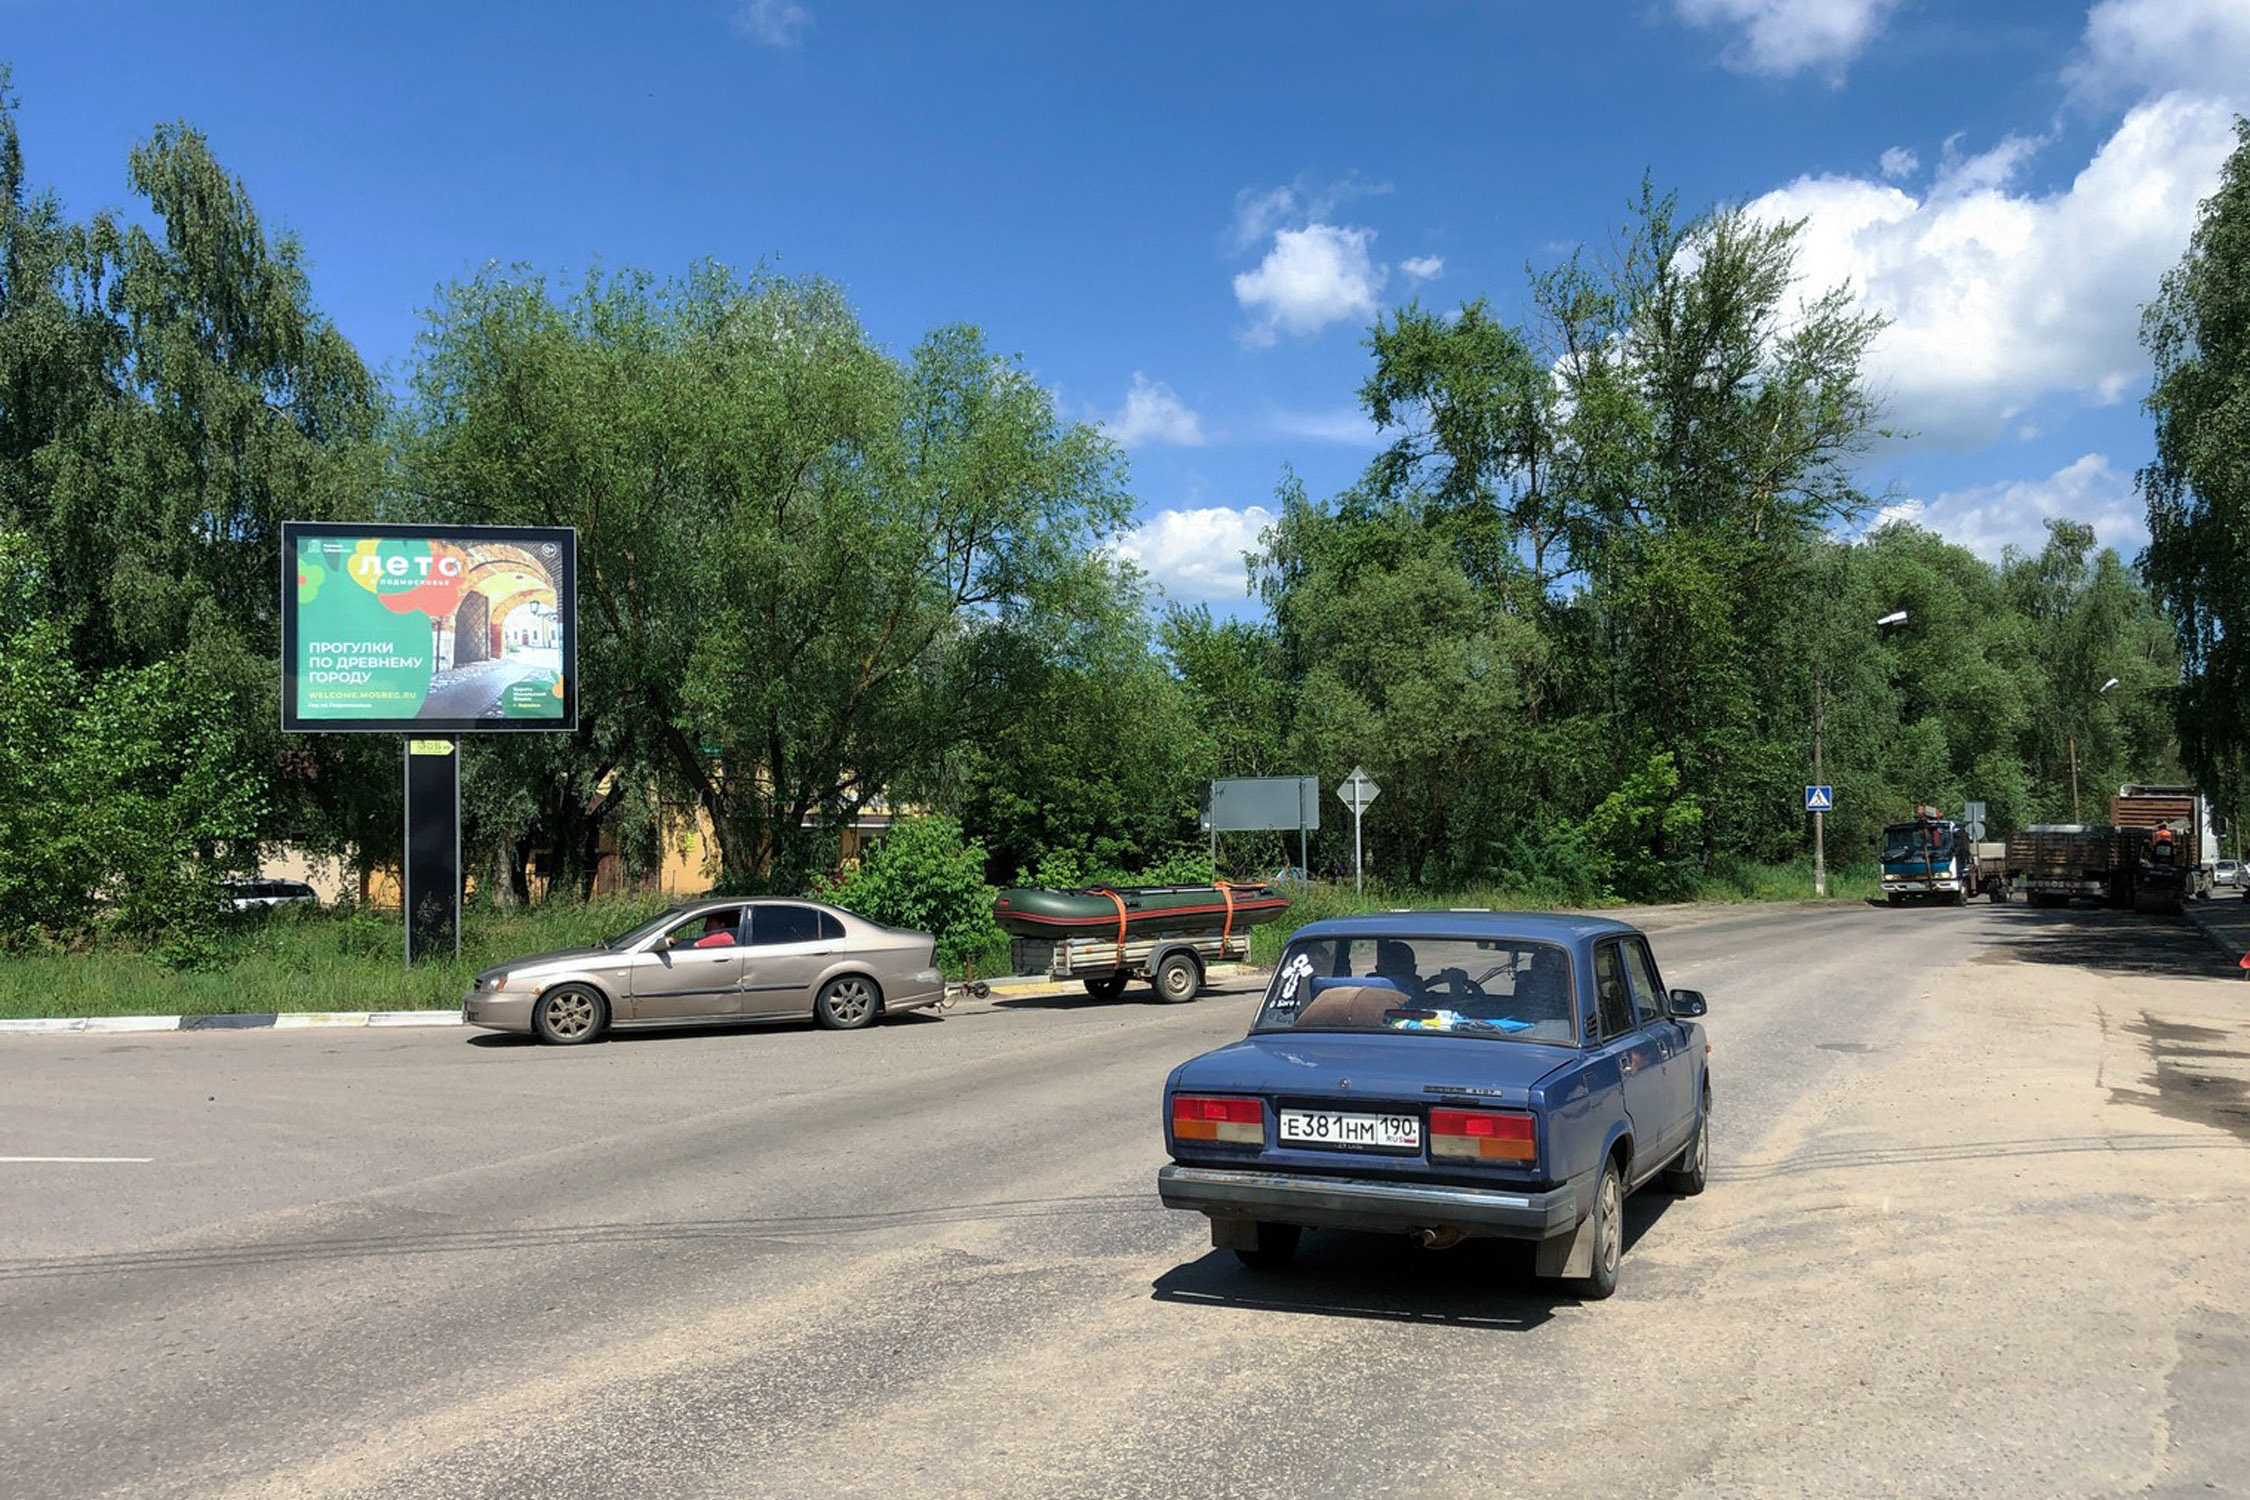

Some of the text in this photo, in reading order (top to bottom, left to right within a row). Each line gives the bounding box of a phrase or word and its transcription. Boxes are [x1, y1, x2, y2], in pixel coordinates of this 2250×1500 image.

[308, 642, 394, 654] ПРОГУЛКИ
[308, 656, 423, 671] ПО ДРЕВНЕМУ
[308, 671, 372, 685] ГОРОДУ
[308, 691, 417, 700] WELCOME.MOSREG.RU
[1379, 1117, 1413, 1136] 190
[1385, 1135, 1404, 1143] RUS
